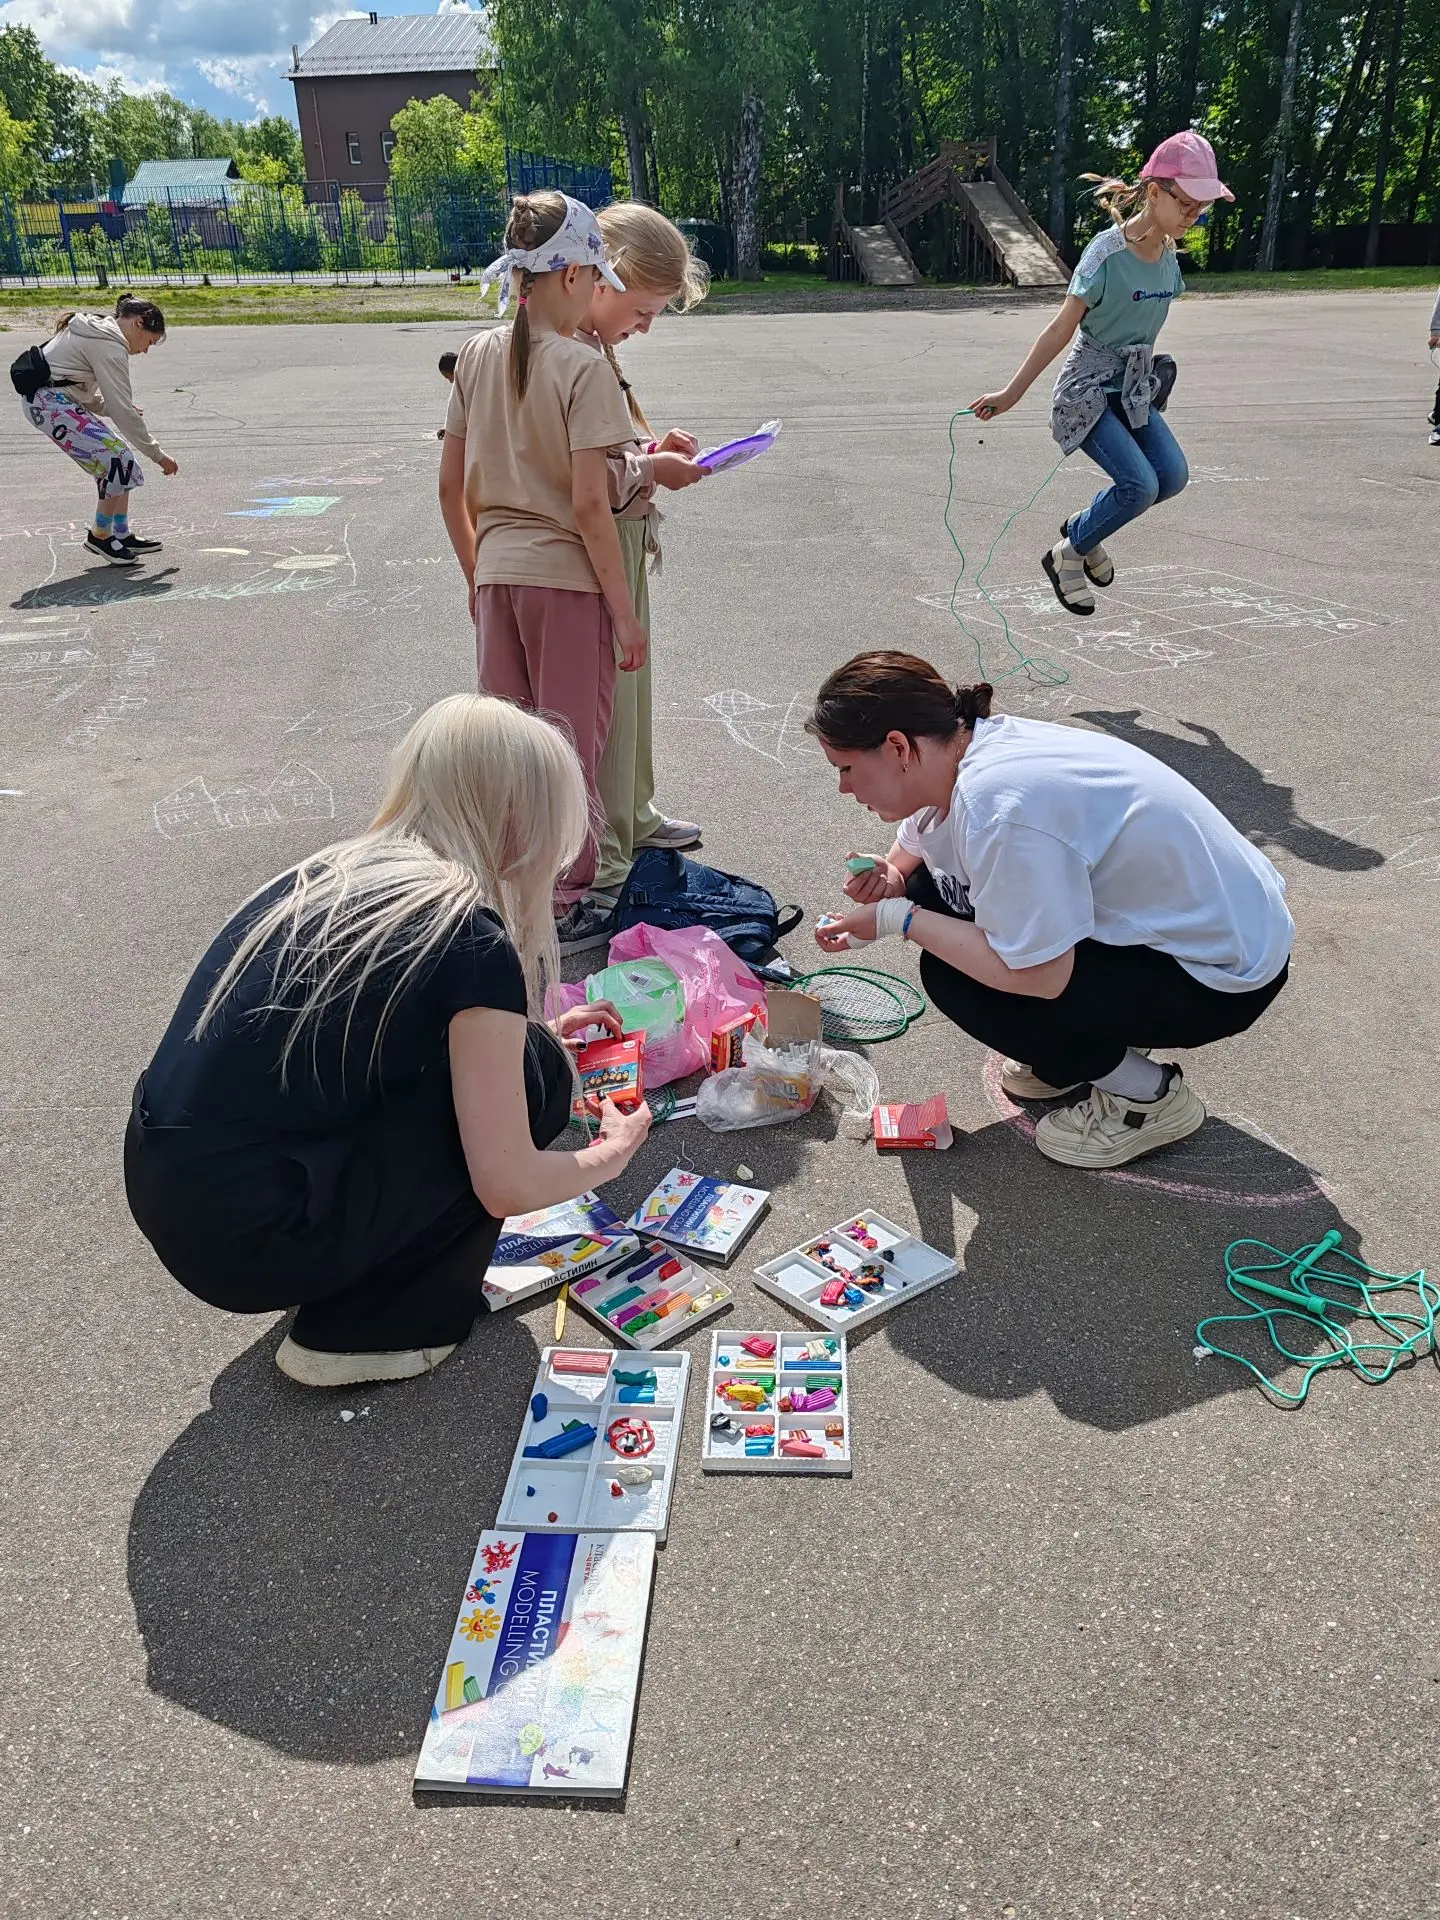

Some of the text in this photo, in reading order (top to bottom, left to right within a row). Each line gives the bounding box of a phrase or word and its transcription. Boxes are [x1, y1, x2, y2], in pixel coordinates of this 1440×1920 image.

[669, 1185, 710, 1232] MODELLING CLAY
[685, 1193, 715, 1229] ПЛАСТИЛИН
[540, 1258, 598, 1290] ПЛАСТИЛИН
[489, 1570, 540, 1729] MODELLING CLAY
[519, 1590, 558, 1706] ПЛАСТИЛИН
